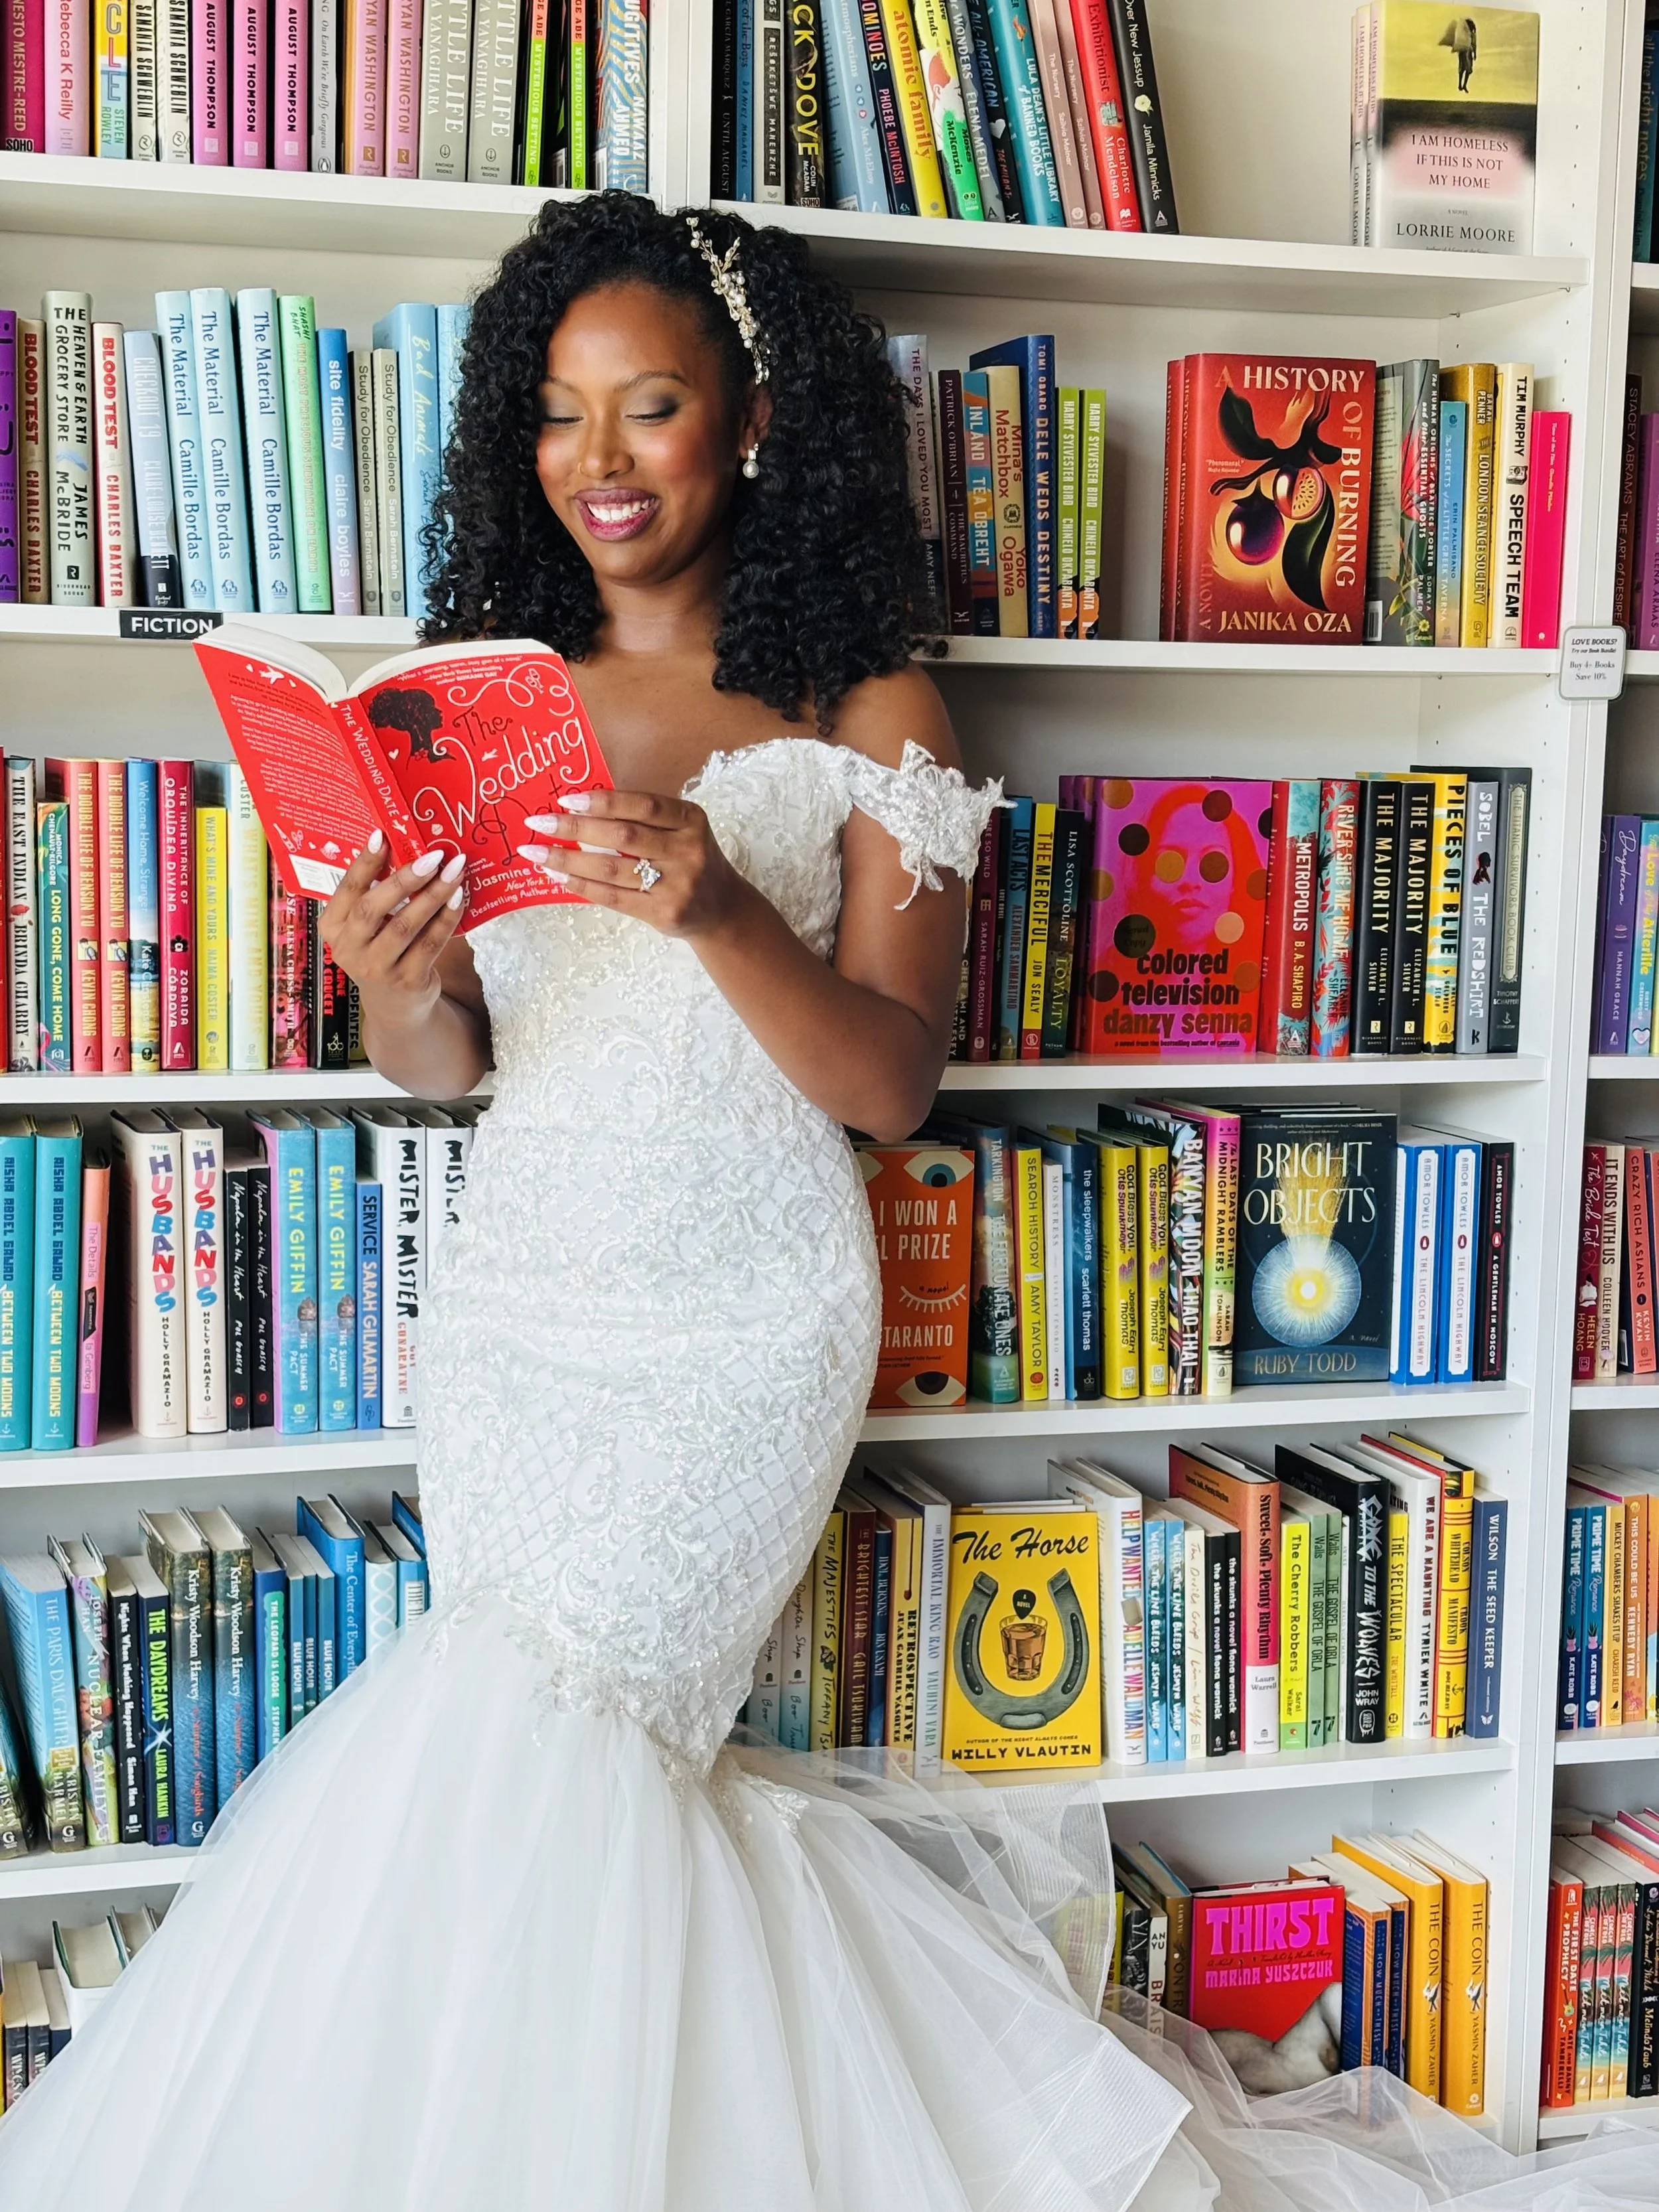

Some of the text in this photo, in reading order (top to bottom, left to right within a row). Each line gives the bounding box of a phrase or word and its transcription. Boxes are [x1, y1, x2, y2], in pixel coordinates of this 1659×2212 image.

[247, 7, 257, 133] AUGUST THOMPSON
[1088, 5, 1110, 92] Exhibitionist
[1022, 97, 1045, 177] BANNED BOOKS
[1027, 58, 1059, 202] LULA DEAN'S LITTLE LIBRARY
[1412, 134, 1508, 152] I AM HOMELESS
[1143, 124, 1161, 200] Jamila Minnicks
[1416, 154, 1502, 171] IF THIS IS NOT
[1429, 175, 1490, 188] MY HOME
[1396, 223, 1515, 242] LORRIE MOORE
[54, 308, 86, 320] THE
[55, 326, 69, 442] GROCERY STORE
[74, 326, 88, 444] HEAVEN & EARTH
[102, 338, 117, 449] BLOOD TEST
[170, 313, 192, 415] The Material
[969, 406, 983, 461] INLAND
[1514, 376, 1527, 457] TIM MURPHY
[995, 409, 1009, 498] Matchbox
[1011, 425, 1022, 482] Mina's
[1215, 366, 1364, 587] A HISTORY OF BURNING
[56, 471, 70, 552] McBRIDE
[74, 482, 88, 540] JAMES
[179, 439, 201, 559] Camille Bordas
[972, 477, 991, 565] TÉA OBREHT
[1035, 418, 1051, 604] DELE WEDS DESTINY
[999, 536, 1015, 597] Ogawa
[1015, 548, 1025, 588] Yoko
[1505, 493, 1523, 618] SPEECH TEAM
[131, 617, 213, 634] FICTION
[1219, 611, 1352, 632] JANIKA OZA
[1569, 661, 1582, 670] Buy
[453, 707, 512, 747] The
[343, 703, 399, 816] THE WEDDING DATE
[414, 716, 592, 837] Wedding
[165, 778, 175, 855] ORQUÍDEA
[1477, 792, 1492, 842] SOBEL
[474, 866, 530, 891] Jasmine
[1293, 842, 1311, 932] METROPOLIS
[1406, 794, 1428, 934] THE MAJORITY
[1441, 785, 1464, 954] PIECES OF BLUE
[470, 894, 518, 917] Bestselling
[51, 890, 64, 1041] LONG GONE, COME HOME
[1137, 948, 1228, 974] colored
[1470, 893, 1488, 1018] THE REDSHIRT
[1614, 952, 1623, 988] HANNAH
[1122, 978, 1239, 1005] television
[1104, 1009, 1252, 1038] danzy senna
[1257, 1142, 1372, 1178] BRIGHT
[149, 1155, 176, 1312] HUSBANDS
[289, 1168, 305, 1293] EMILY GIFFIN
[880, 1200, 957, 1226] I WON A
[1244, 1187, 1375, 1225] OBJECTS
[1602, 1159, 1618, 1264] IT ENDS WITH US
[899, 1234, 950, 1259] PRIZE
[362, 1262, 378, 1398] SARAH GILMARTIN
[885, 1325, 952, 1347] TARANTO
[1577, 1313, 1585, 1351] HOANG
[1254, 1353, 1356, 1374] RUBY TODD
[1425, 1519, 1435, 1540] ARE
[1426, 1497, 1435, 1514] WE
[952, 1527, 1088, 1564] The Horse
[1289, 1535, 1301, 1672] The Cherry Robbers
[1423, 1557, 1433, 1617] HAUNTING
[1484, 1514, 1499, 1668] WILSON THE SEED KEEPER
[227, 1566, 243, 1700] Kristy Woodson Harvey
[149, 1609, 169, 1724] THE DAYDREAMS
[1355, 1698, 1378, 1706] WRAY
[952, 1744, 1091, 1759] WILLY VLAUTIN
[1206, 1898, 1334, 1955] THIRST
[1471, 1901, 1483, 1974] THE COIN
[1561, 1923, 1570, 1980] PROPHECY
[1205, 1961, 1333, 1988] MARINA YUSZCZUK
